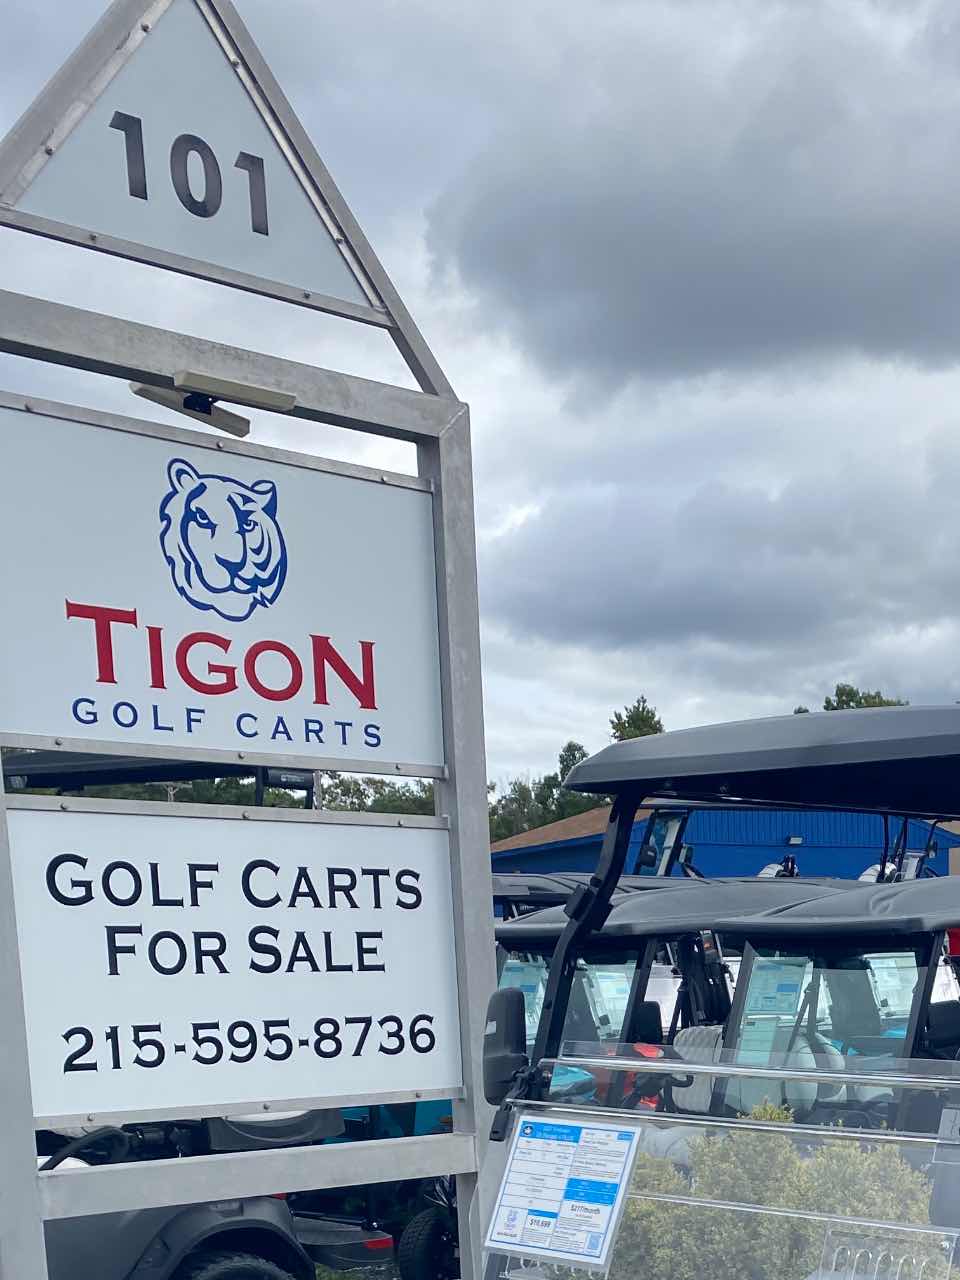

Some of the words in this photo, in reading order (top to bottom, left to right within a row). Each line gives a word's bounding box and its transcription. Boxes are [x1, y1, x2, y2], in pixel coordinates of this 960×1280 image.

[109, 111, 269, 236] 101
[65, 599, 378, 710] TIGON
[72, 698, 205, 733] GOLF
[236, 713, 382, 748] CARTS
[46, 853, 219, 908] GOLF
[242, 859, 422, 909] CARTS
[104, 924, 230, 975] FOR
[248, 925, 385, 974] SALE
[61, 1013, 436, 1075] 215-595-8736
